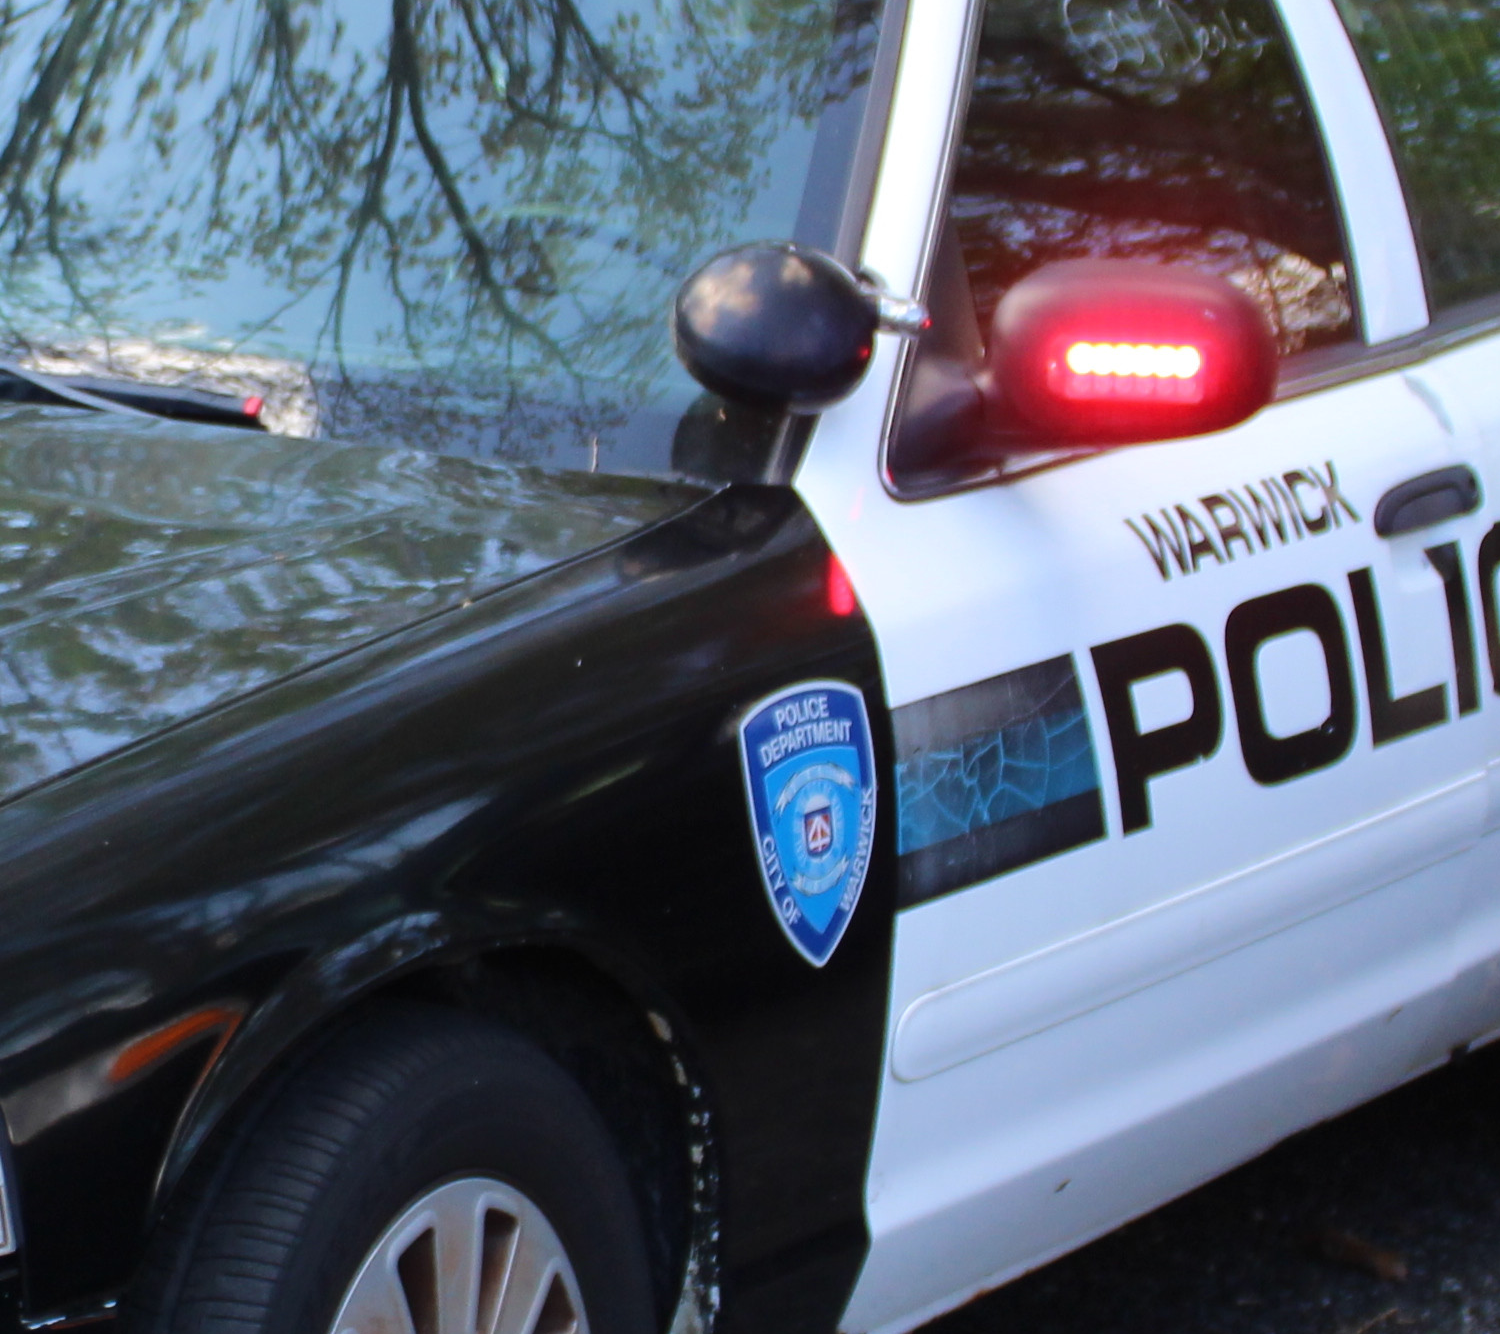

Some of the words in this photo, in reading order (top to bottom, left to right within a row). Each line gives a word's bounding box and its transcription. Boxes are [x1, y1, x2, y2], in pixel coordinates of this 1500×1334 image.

[1125, 461, 1361, 582] WARWICK
[760, 720, 852, 768] DEPARTMENT
[775, 695, 829, 730] POLICE
[763, 834, 786, 892] CITY
[782, 896, 802, 925] OF
[840, 787, 873, 912] WARWICK
